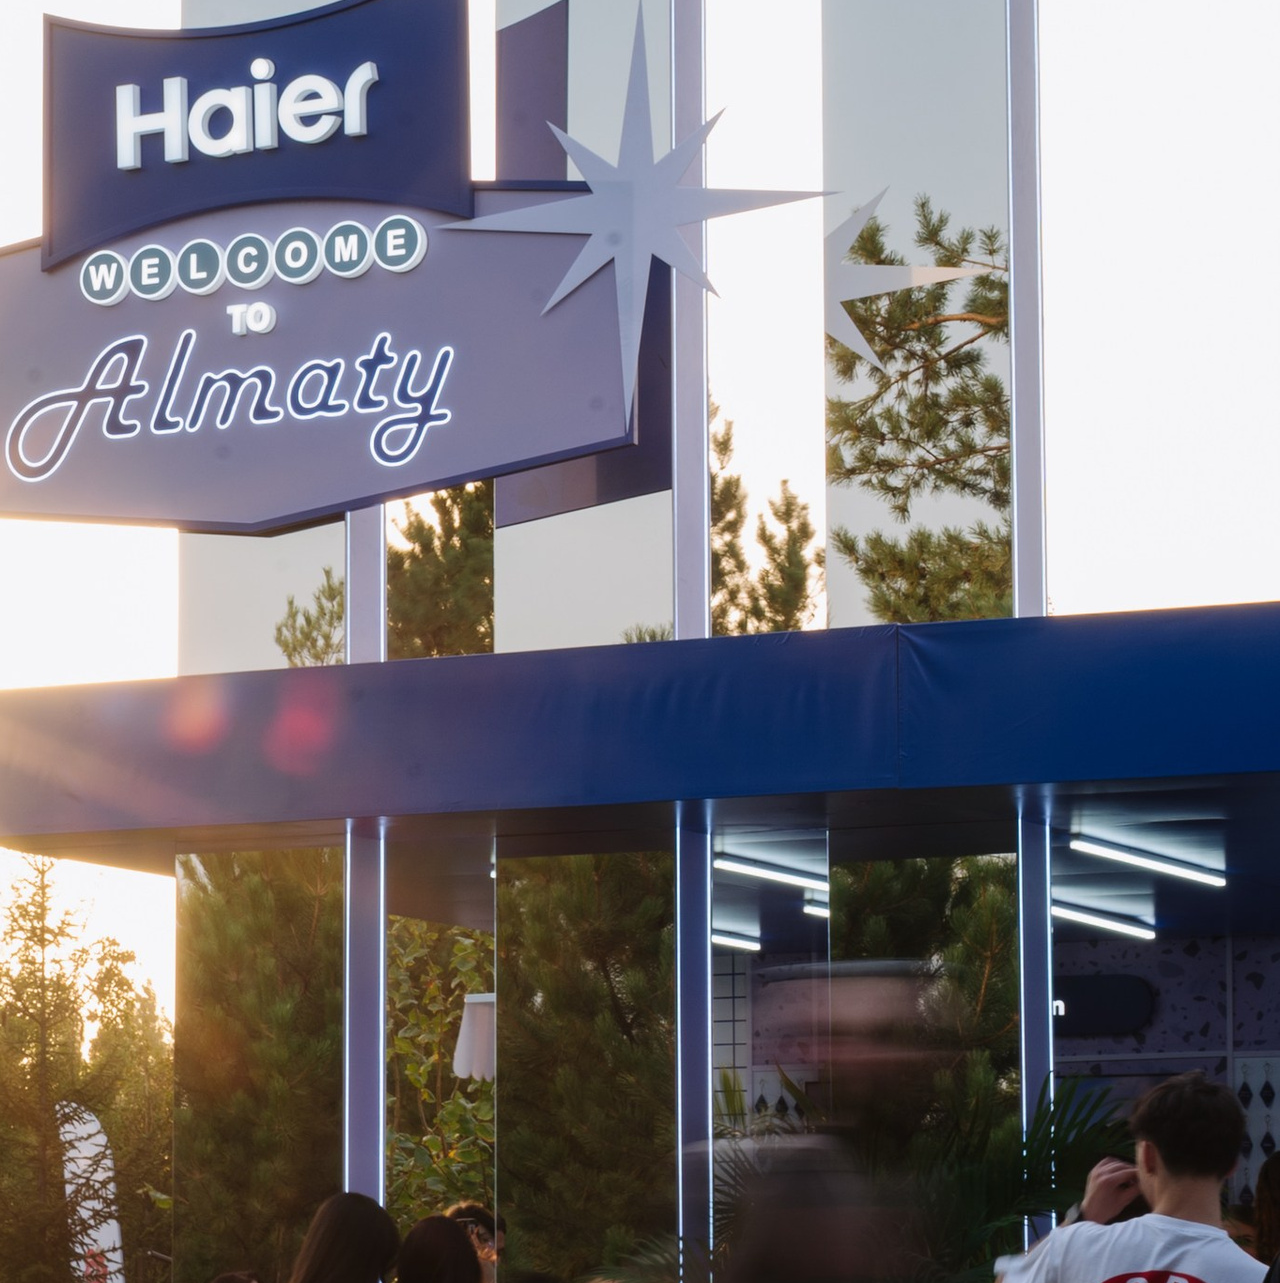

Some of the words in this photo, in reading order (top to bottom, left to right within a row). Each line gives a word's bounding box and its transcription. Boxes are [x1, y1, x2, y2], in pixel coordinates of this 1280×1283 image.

[116, 58, 379, 170] Haier
[88, 227, 407, 292] WELCOME
[226, 301, 276, 336] TO
[5, 329, 455, 483] Almaty
